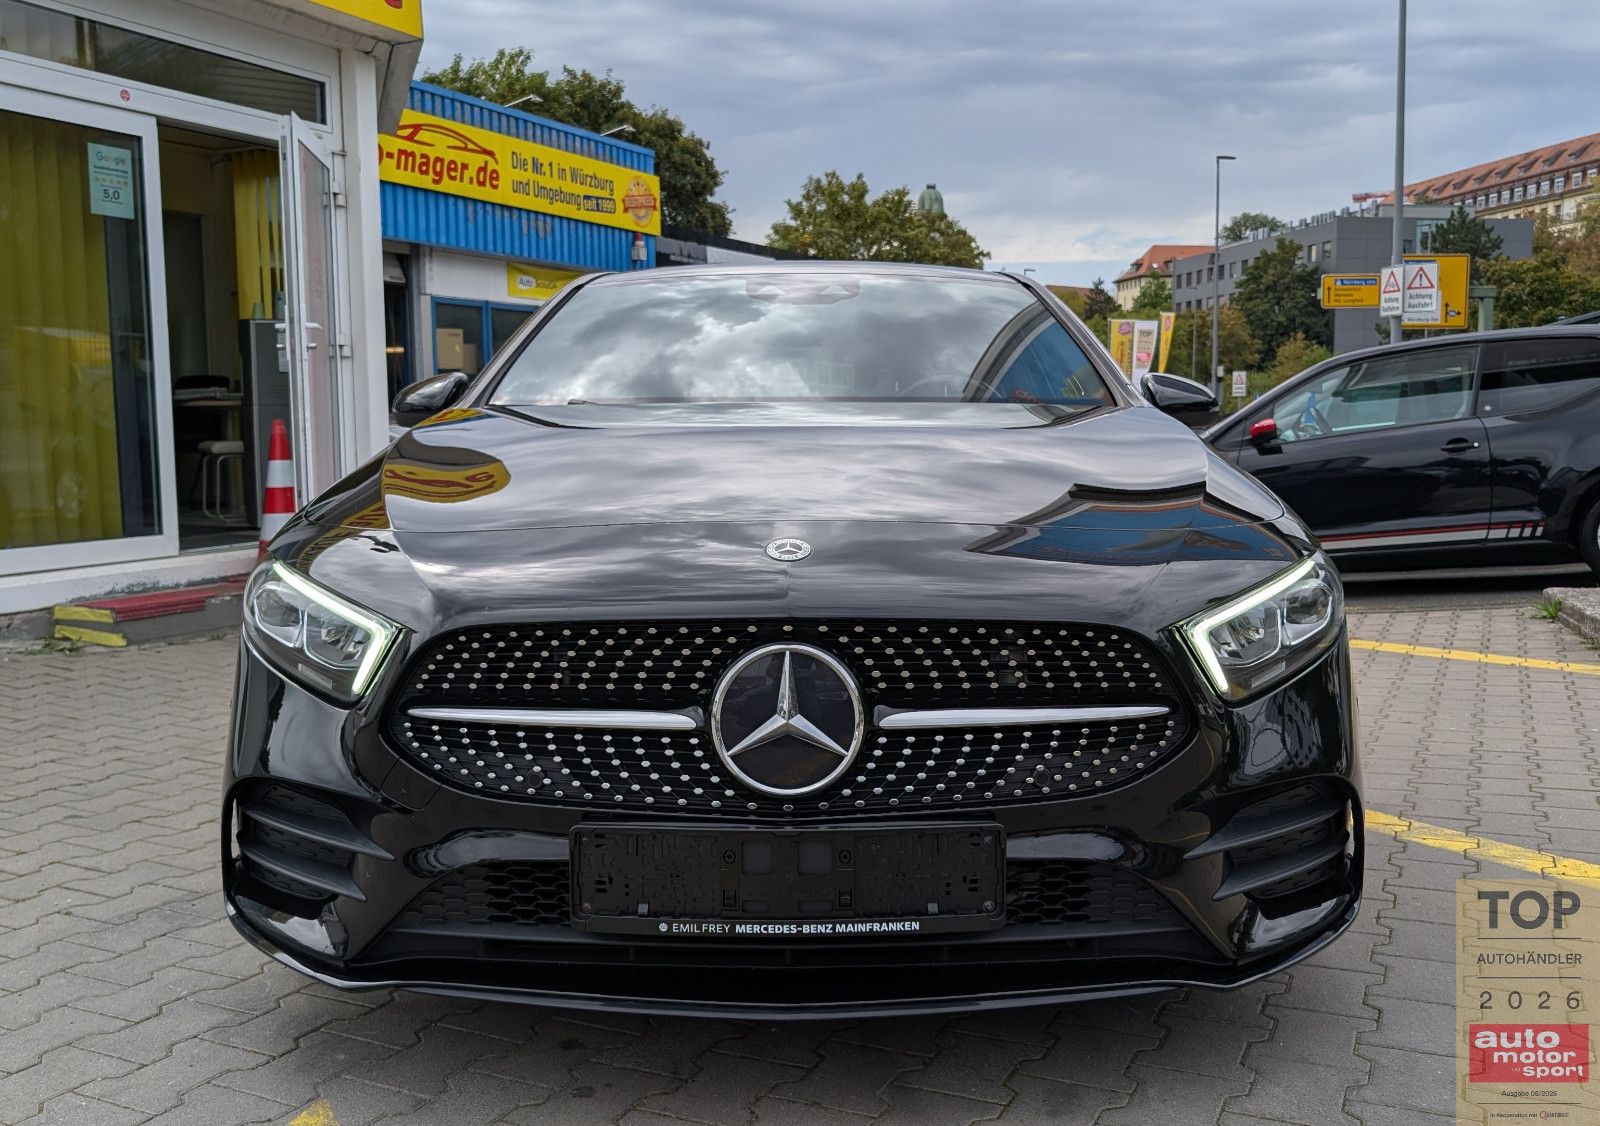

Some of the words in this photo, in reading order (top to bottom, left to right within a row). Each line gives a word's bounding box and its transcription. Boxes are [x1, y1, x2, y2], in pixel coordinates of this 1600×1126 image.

[95, 151, 128, 166] Google
[511, 151, 528, 172] Die
[557, 163, 567, 181] in
[569, 166, 615, 196] Würzburg
[103, 188, 121, 201] 5,0
[511, 179, 530, 195] und
[533, 180, 582, 211] Umgebung
[584, 198, 598, 212] seit
[600, 199, 616, 213] 1999
[672, 923, 700, 933] EMIL
[702, 923, 730, 933] FREY
[735, 923, 834, 934] MERCEDES-BENZ
[835, 921, 920, 932] MAINFRANKEN
